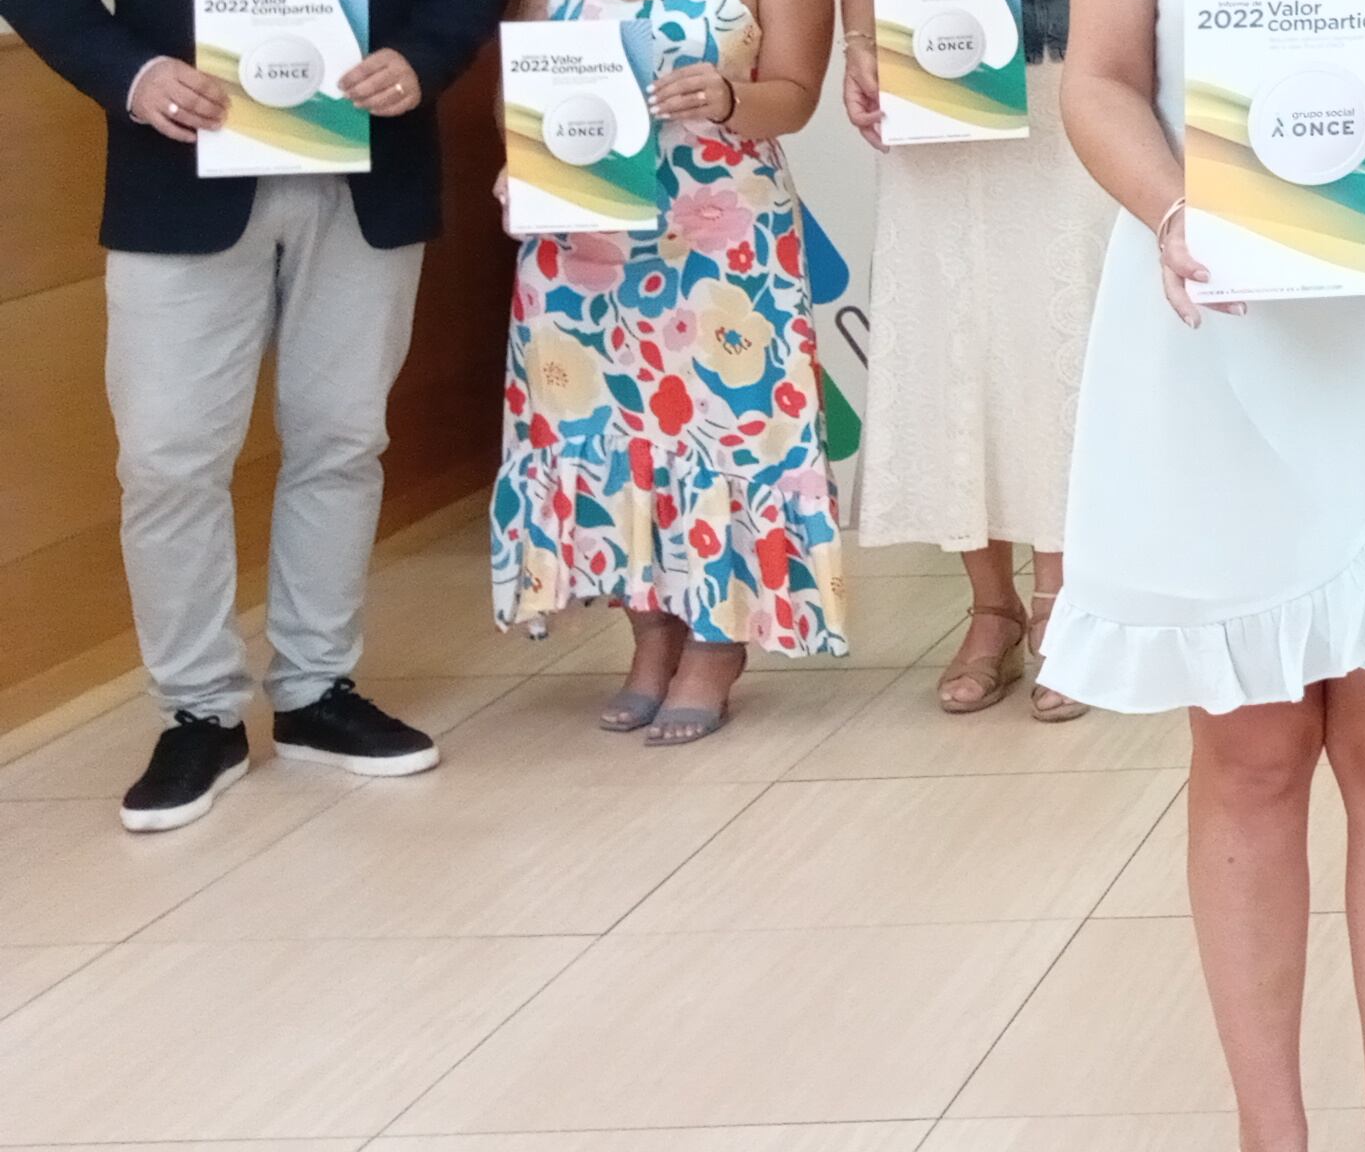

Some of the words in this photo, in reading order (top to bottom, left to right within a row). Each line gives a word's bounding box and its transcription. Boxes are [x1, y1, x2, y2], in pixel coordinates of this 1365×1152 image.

[204, 0, 249, 13] 2022
[251, 2, 333, 16] compartido
[1198, 9, 1263, 29] 2022
[1267, 0, 1322, 16] Valor
[938, 41, 973, 51] ONCE
[510, 60, 549, 72] 2022
[551, 54, 583, 65] Valor
[552, 62, 623, 74] compartido
[268, 68, 310, 79] ONCE
[1292, 111, 1323, 120] grupo
[1325, 108, 1355, 117] social
[568, 127, 604, 137] ONCE
[1292, 120, 1354, 136] ONCE
